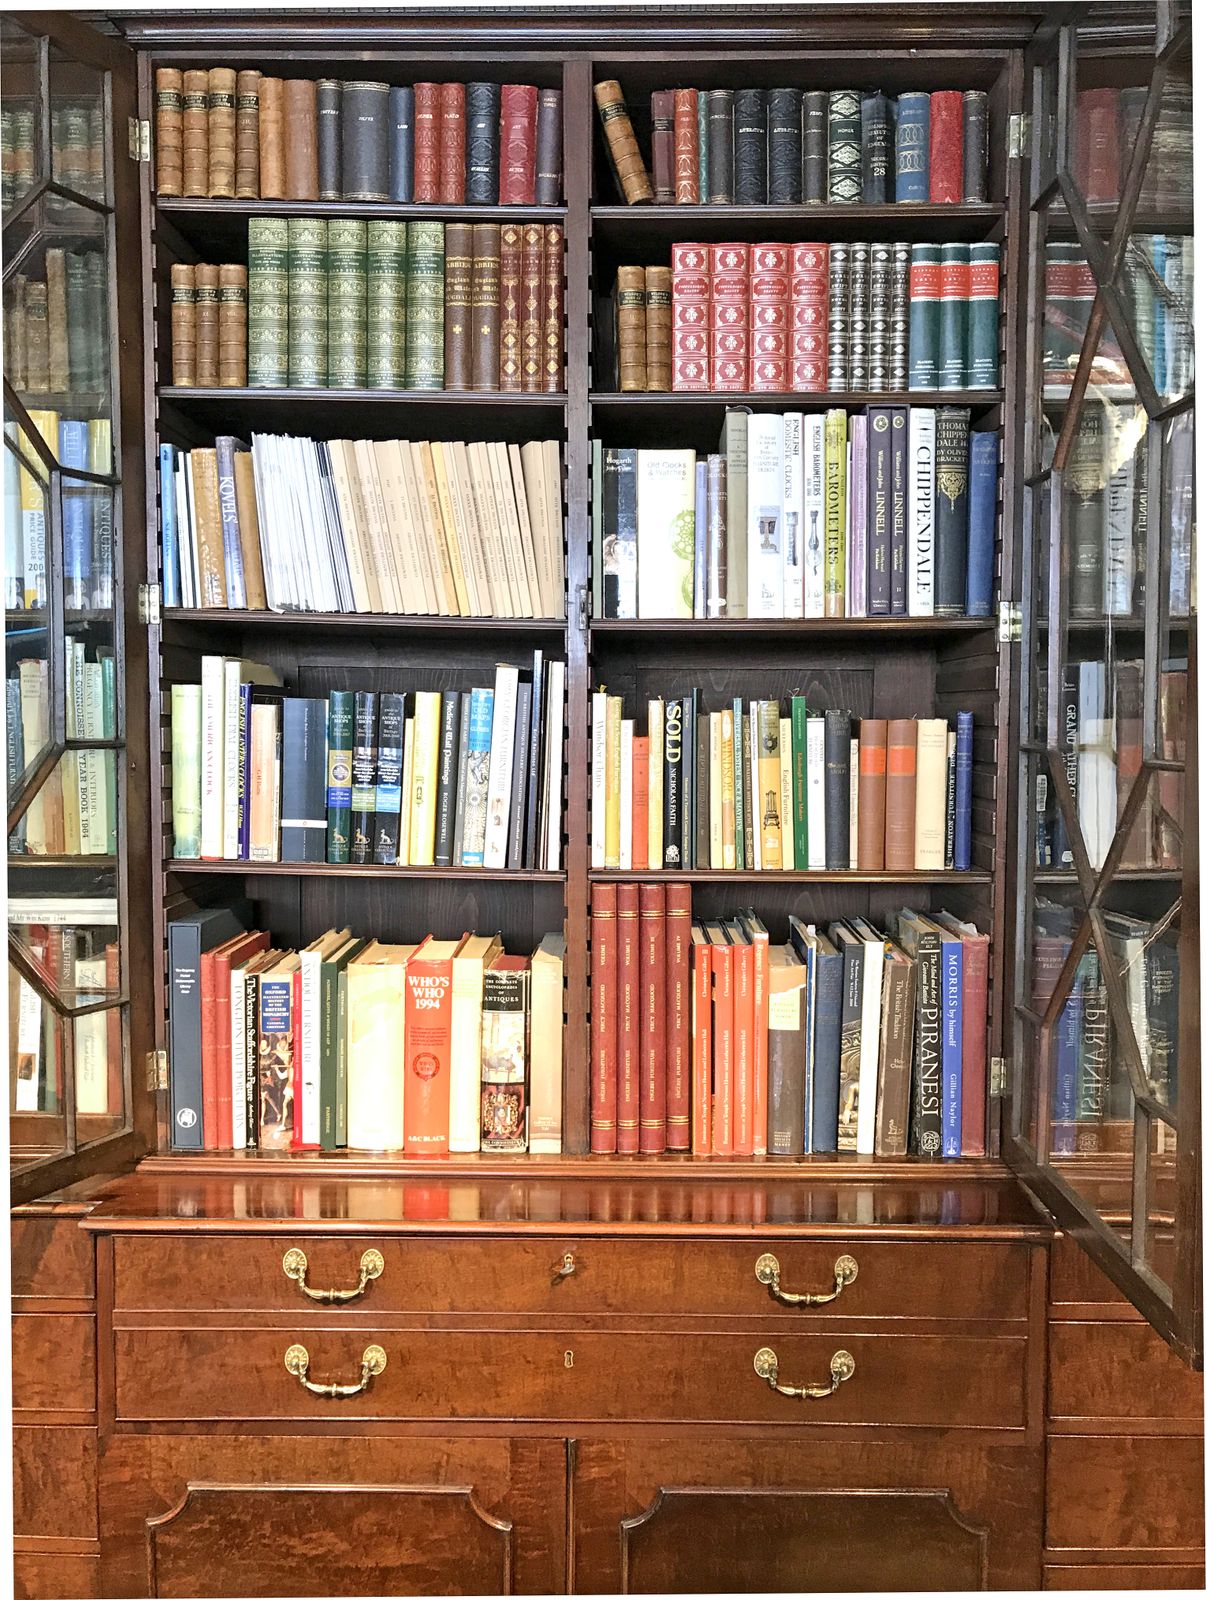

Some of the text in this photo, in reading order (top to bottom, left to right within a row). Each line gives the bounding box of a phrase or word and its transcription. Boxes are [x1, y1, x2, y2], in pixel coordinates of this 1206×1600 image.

[874, 168, 886, 176] 28
[606, 457, 632, 465] Hogarth
[812, 426, 821, 496] ENGLISH BAROMETERS
[828, 462, 840, 564] BAROMETERS
[876, 492, 884, 536] LINNELL
[894, 492, 903, 536] LINNELL
[916, 446, 930, 594] CHIPPENDALE
[28, 563, 44, 572] 200
[75, 655, 83, 676] THE
[446, 701, 454, 730] Medieval
[445, 731, 454, 748] Wall
[596, 720, 604, 758] Windsor
[666, 705, 682, 762] SOLD
[78, 754, 87, 782] YEAR
[228, 754, 237, 788] CLOCKS
[442, 750, 452, 784] Paintings
[498, 748, 508, 792] FURNITURE
[722, 739, 732, 792] WINDSOR
[408, 976, 450, 987] WHO'S
[412, 988, 444, 998] WHO
[948, 954, 958, 1006] MORRIS
[416, 998, 440, 1010] 1994
[947, 1009, 956, 1018] by
[246, 978, 256, 1101] The Victorian Staffordshire Figure
[893, 1014, 901, 1038] Tradition
[921, 1008, 938, 1116] PIRANESI
